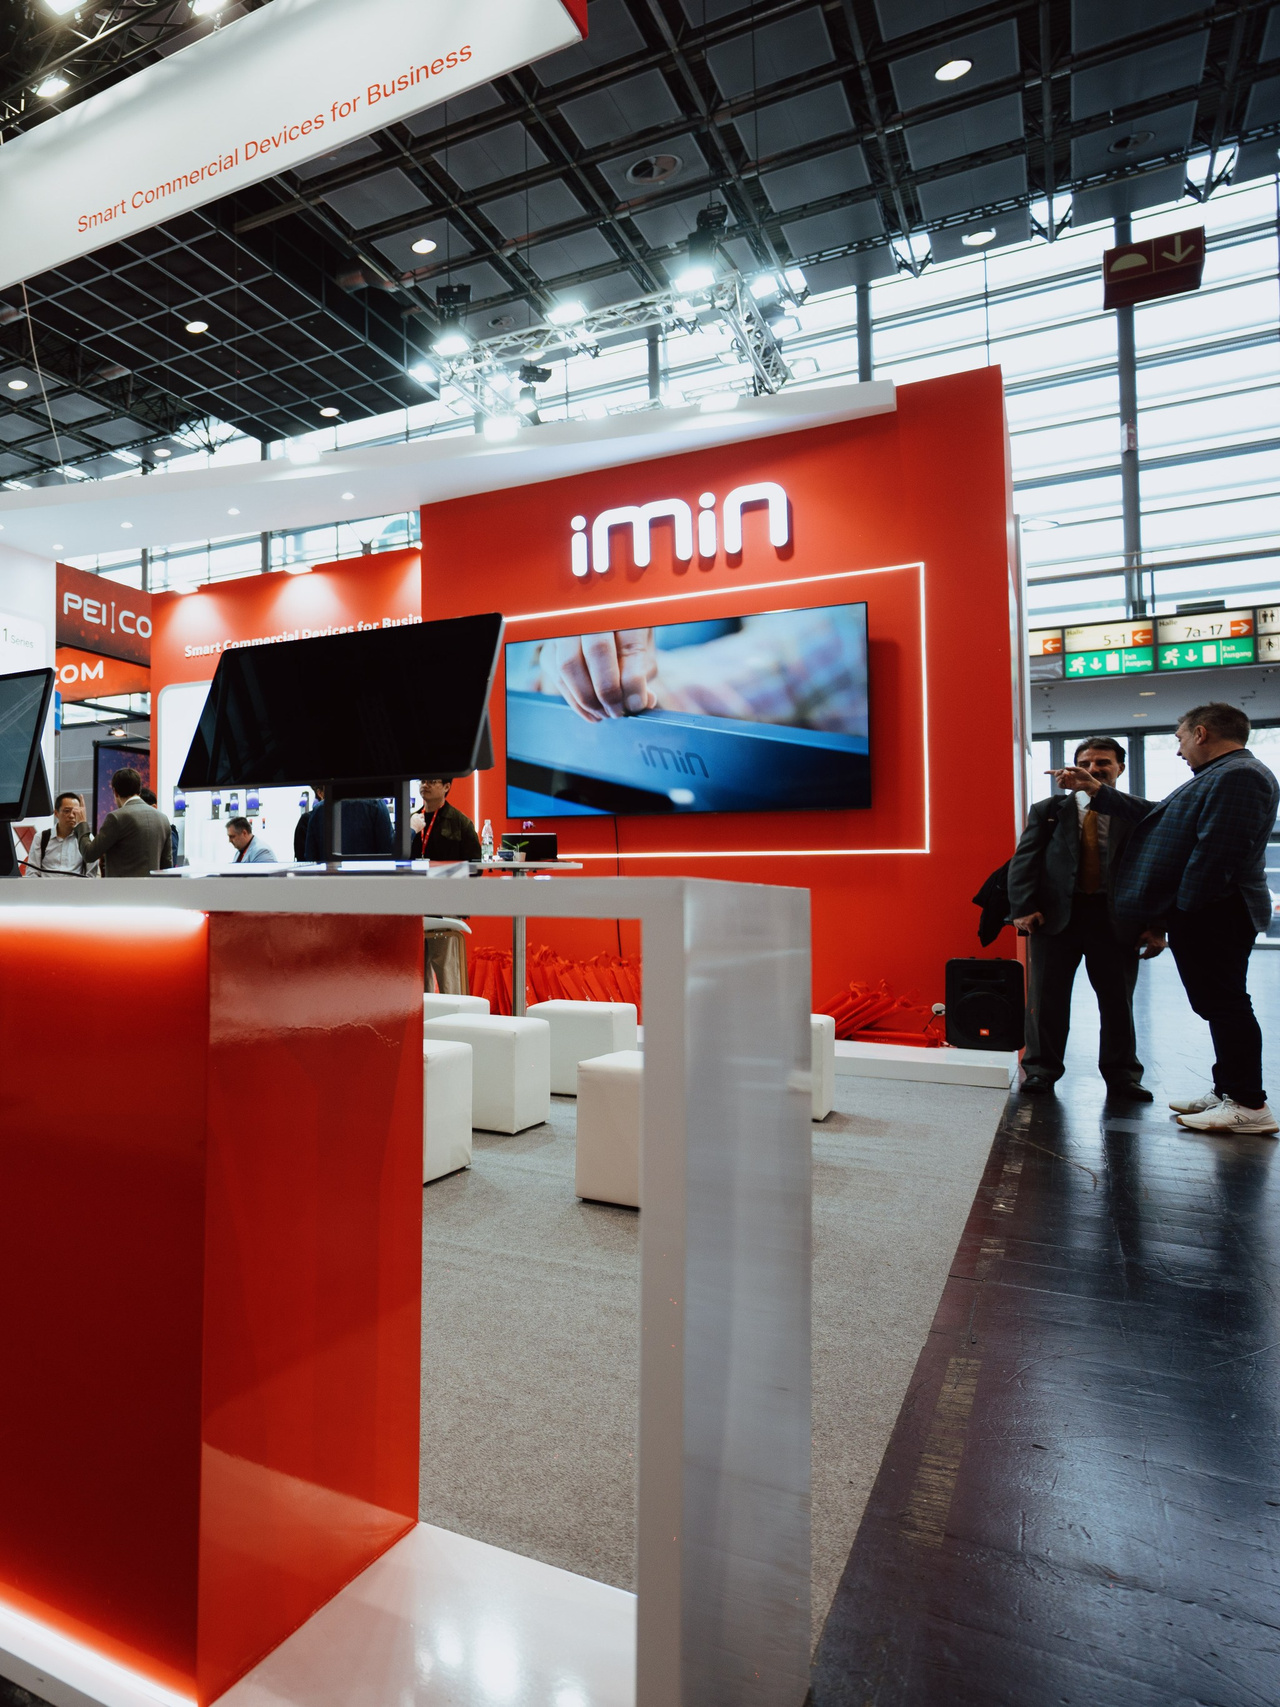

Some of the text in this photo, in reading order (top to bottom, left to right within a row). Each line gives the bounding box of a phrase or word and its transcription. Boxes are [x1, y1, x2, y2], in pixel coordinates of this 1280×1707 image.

[77, 44, 472, 233] Smart Commercial Devices for Business
[3, 628, 8, 642] 1
[10, 635, 34, 649] Series
[184, 642, 221, 658] Smart
[223, 629, 299, 650] Commercial
[302, 625, 355, 640] Devices
[357, 620, 379, 631] for
[1223, 651, 1252, 659] Ausgang
